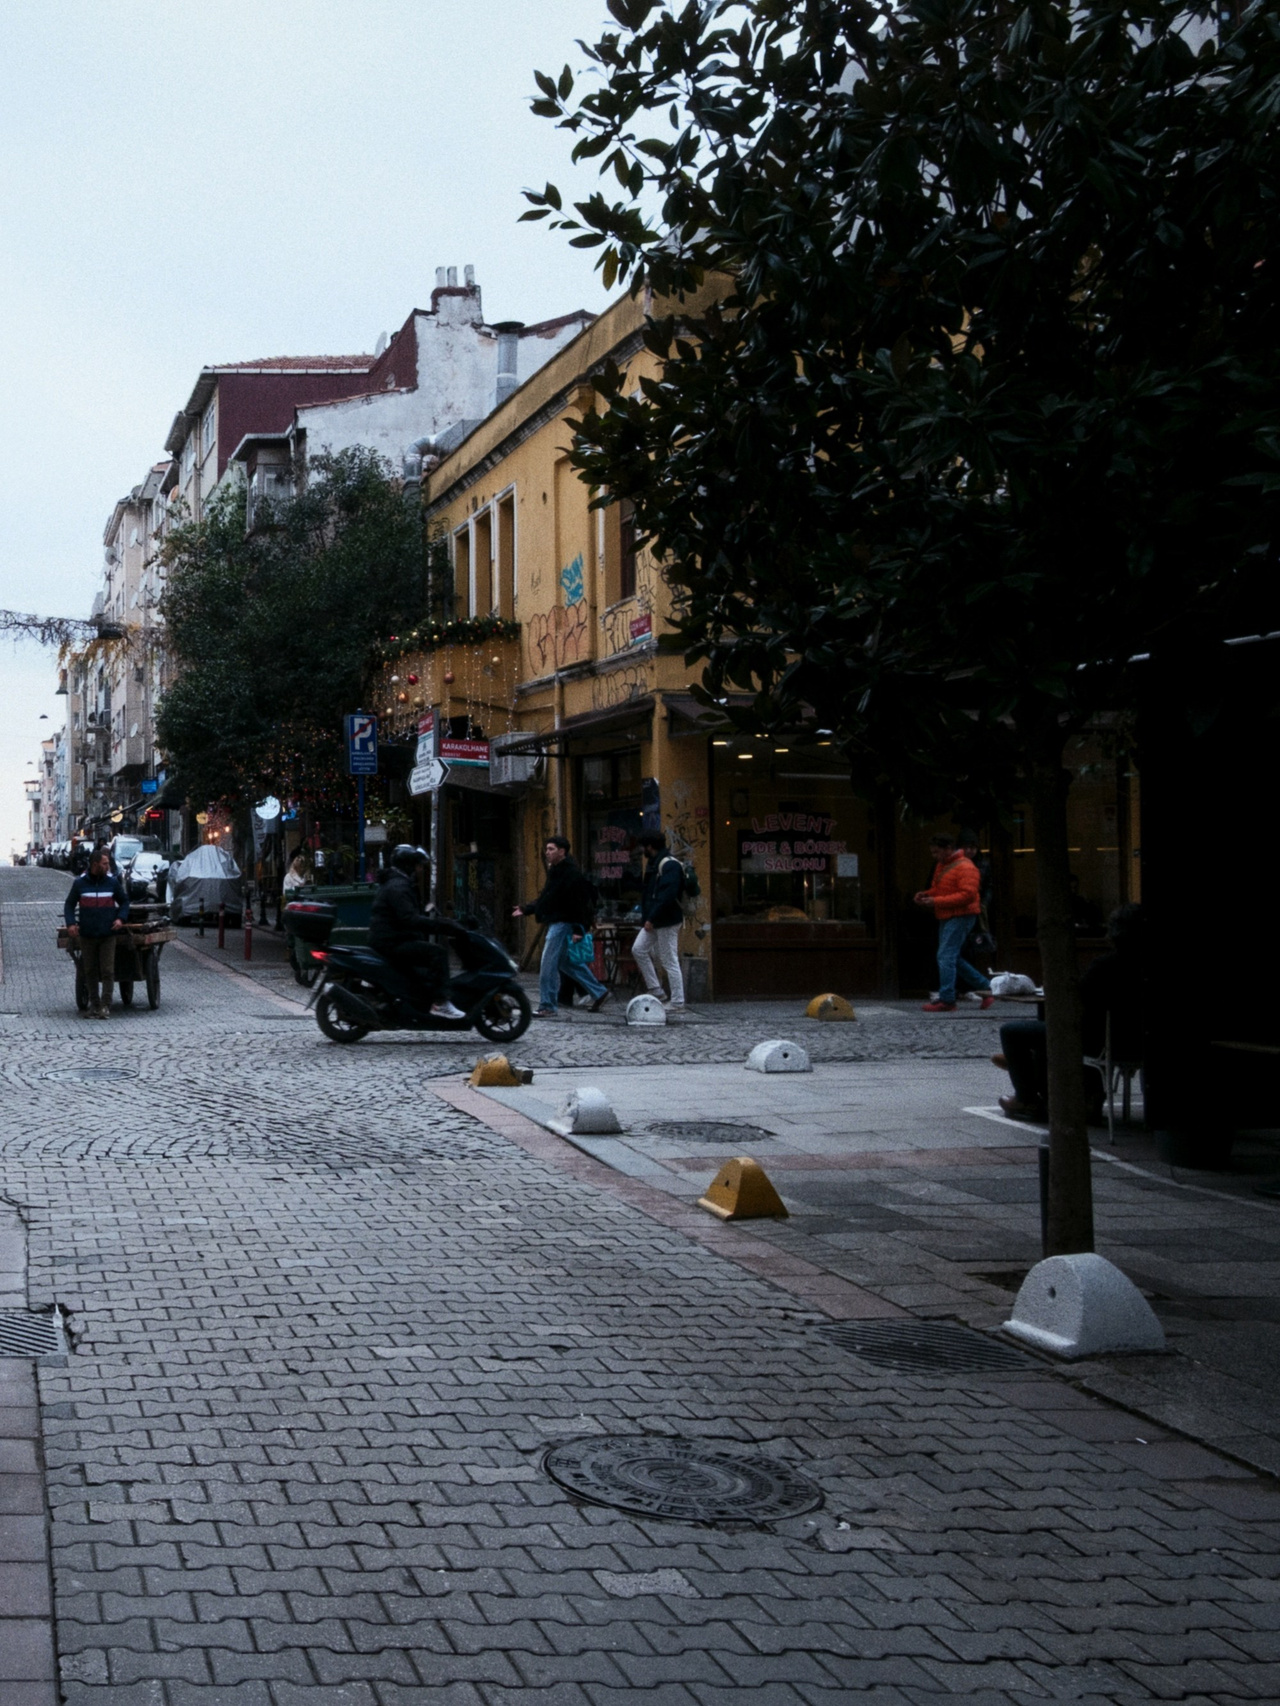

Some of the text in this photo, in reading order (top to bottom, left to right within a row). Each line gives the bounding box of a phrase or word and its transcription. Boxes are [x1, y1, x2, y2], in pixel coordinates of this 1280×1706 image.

[442, 742, 489, 754] KARAKOLHANE
[751, 813, 836, 836] LEVENT
[780, 841, 792, 855] &
[793, 839, 847, 855] BÖREK
[764, 857, 826, 871] SALONU
